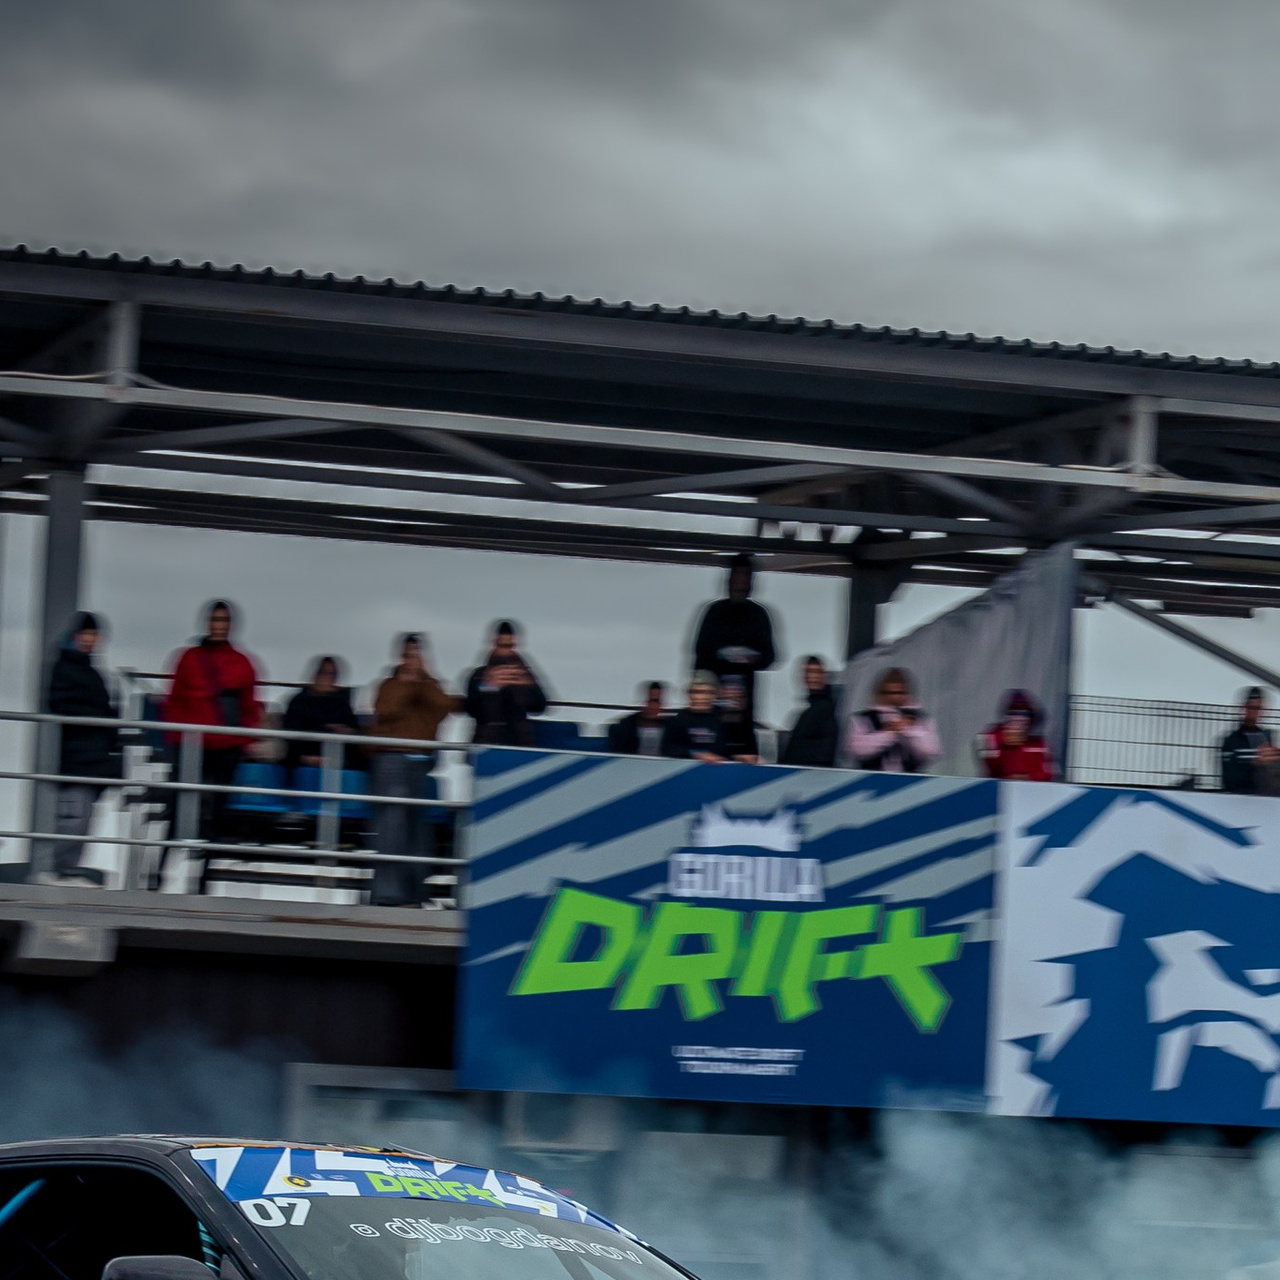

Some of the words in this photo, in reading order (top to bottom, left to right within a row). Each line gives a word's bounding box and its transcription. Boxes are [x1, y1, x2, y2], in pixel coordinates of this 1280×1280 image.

[509, 887, 963, 1033] DRIFT
[365, 1172, 506, 1208] DRIFT
[239, 1197, 311, 1227] 07
[385, 1217, 643, 1265] djbogdanov
